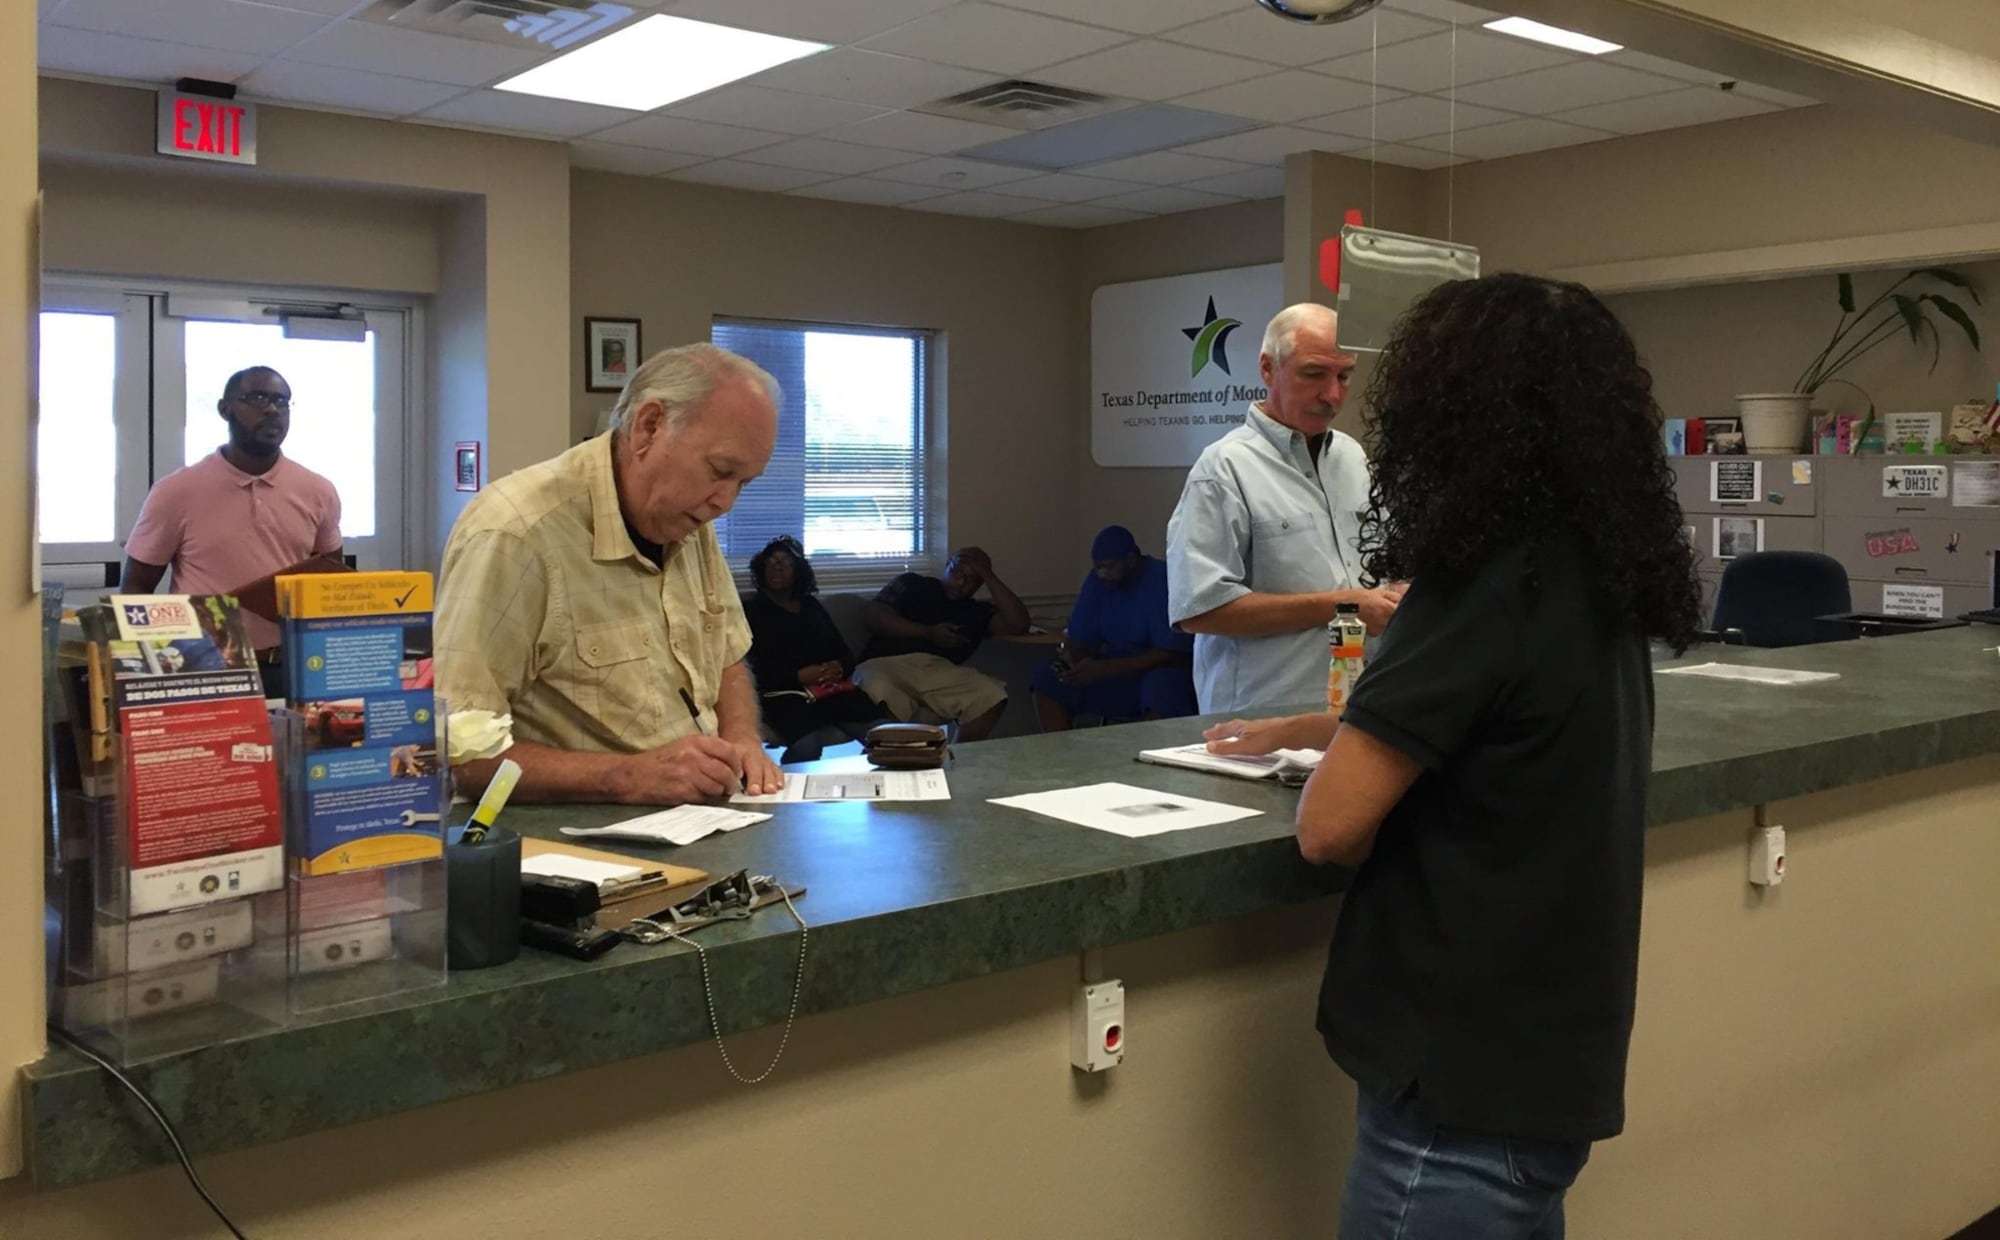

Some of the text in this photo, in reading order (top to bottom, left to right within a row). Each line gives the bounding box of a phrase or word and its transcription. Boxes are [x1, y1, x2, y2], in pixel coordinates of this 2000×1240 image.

[174, 98, 246, 156] EXIT
[1102, 392, 1134, 407] Texas
[1137, 388, 1214, 409] Department
[1215, 385, 1231, 406] of
[1123, 414, 1246, 427] HELPING TEXANS GO. HELPING
[1905, 476, 1939, 491] DH31C
[1866, 533, 1919, 557] USA
[150, 606, 186, 620] ONE
[126, 683, 251, 701] DE DOS PASOS DE TEXAS
